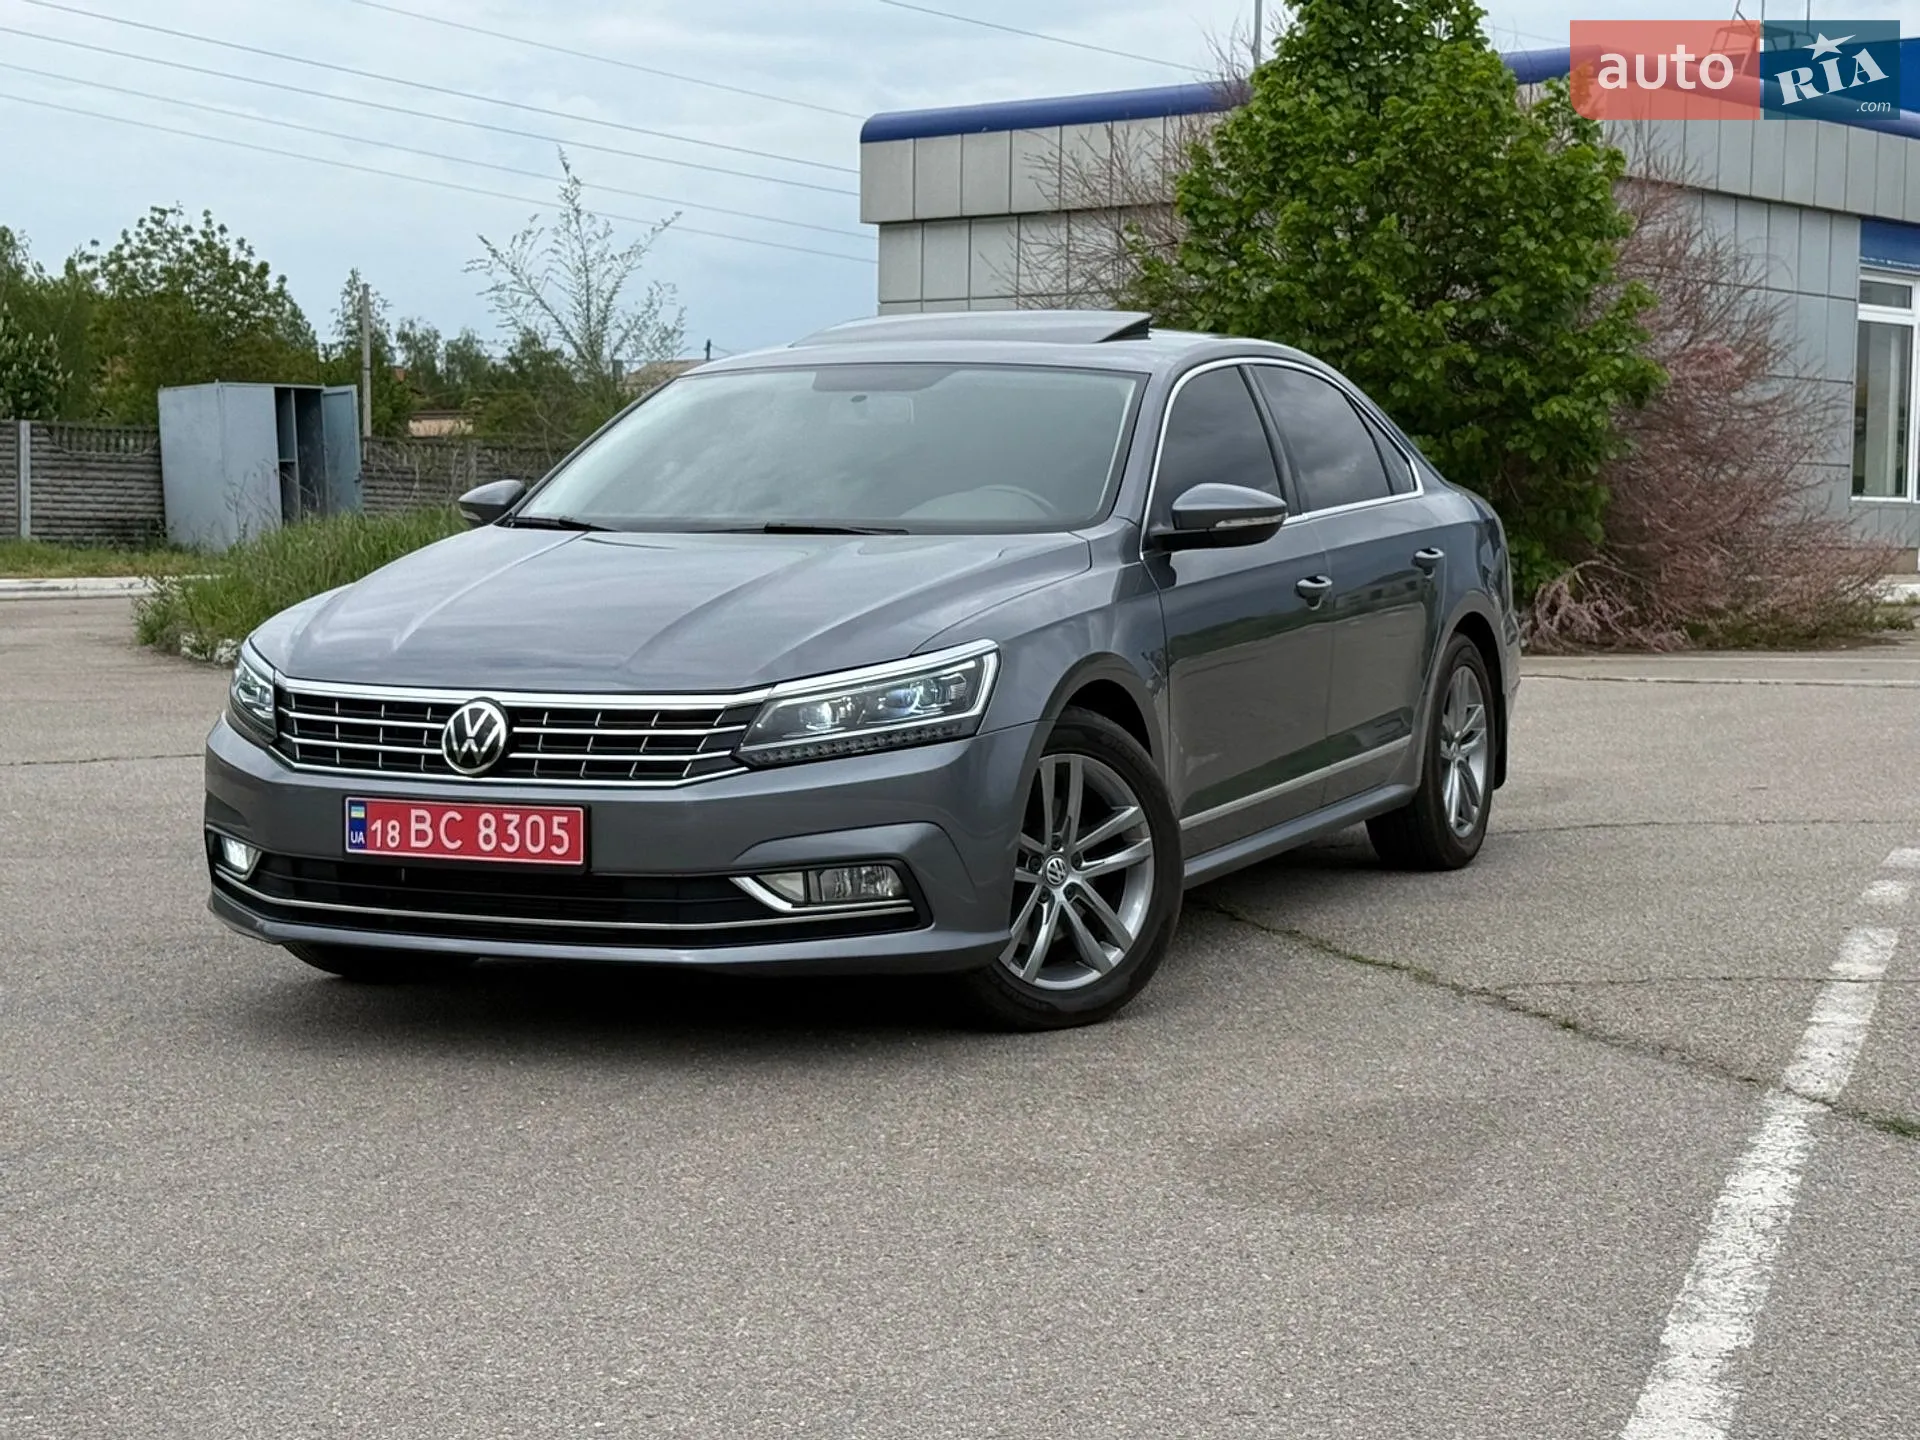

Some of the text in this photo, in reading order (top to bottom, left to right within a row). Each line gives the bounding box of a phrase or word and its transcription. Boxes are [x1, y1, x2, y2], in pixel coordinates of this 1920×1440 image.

[350, 831, 365, 844] UA
[371, 809, 569, 855] 18 BC 8305
